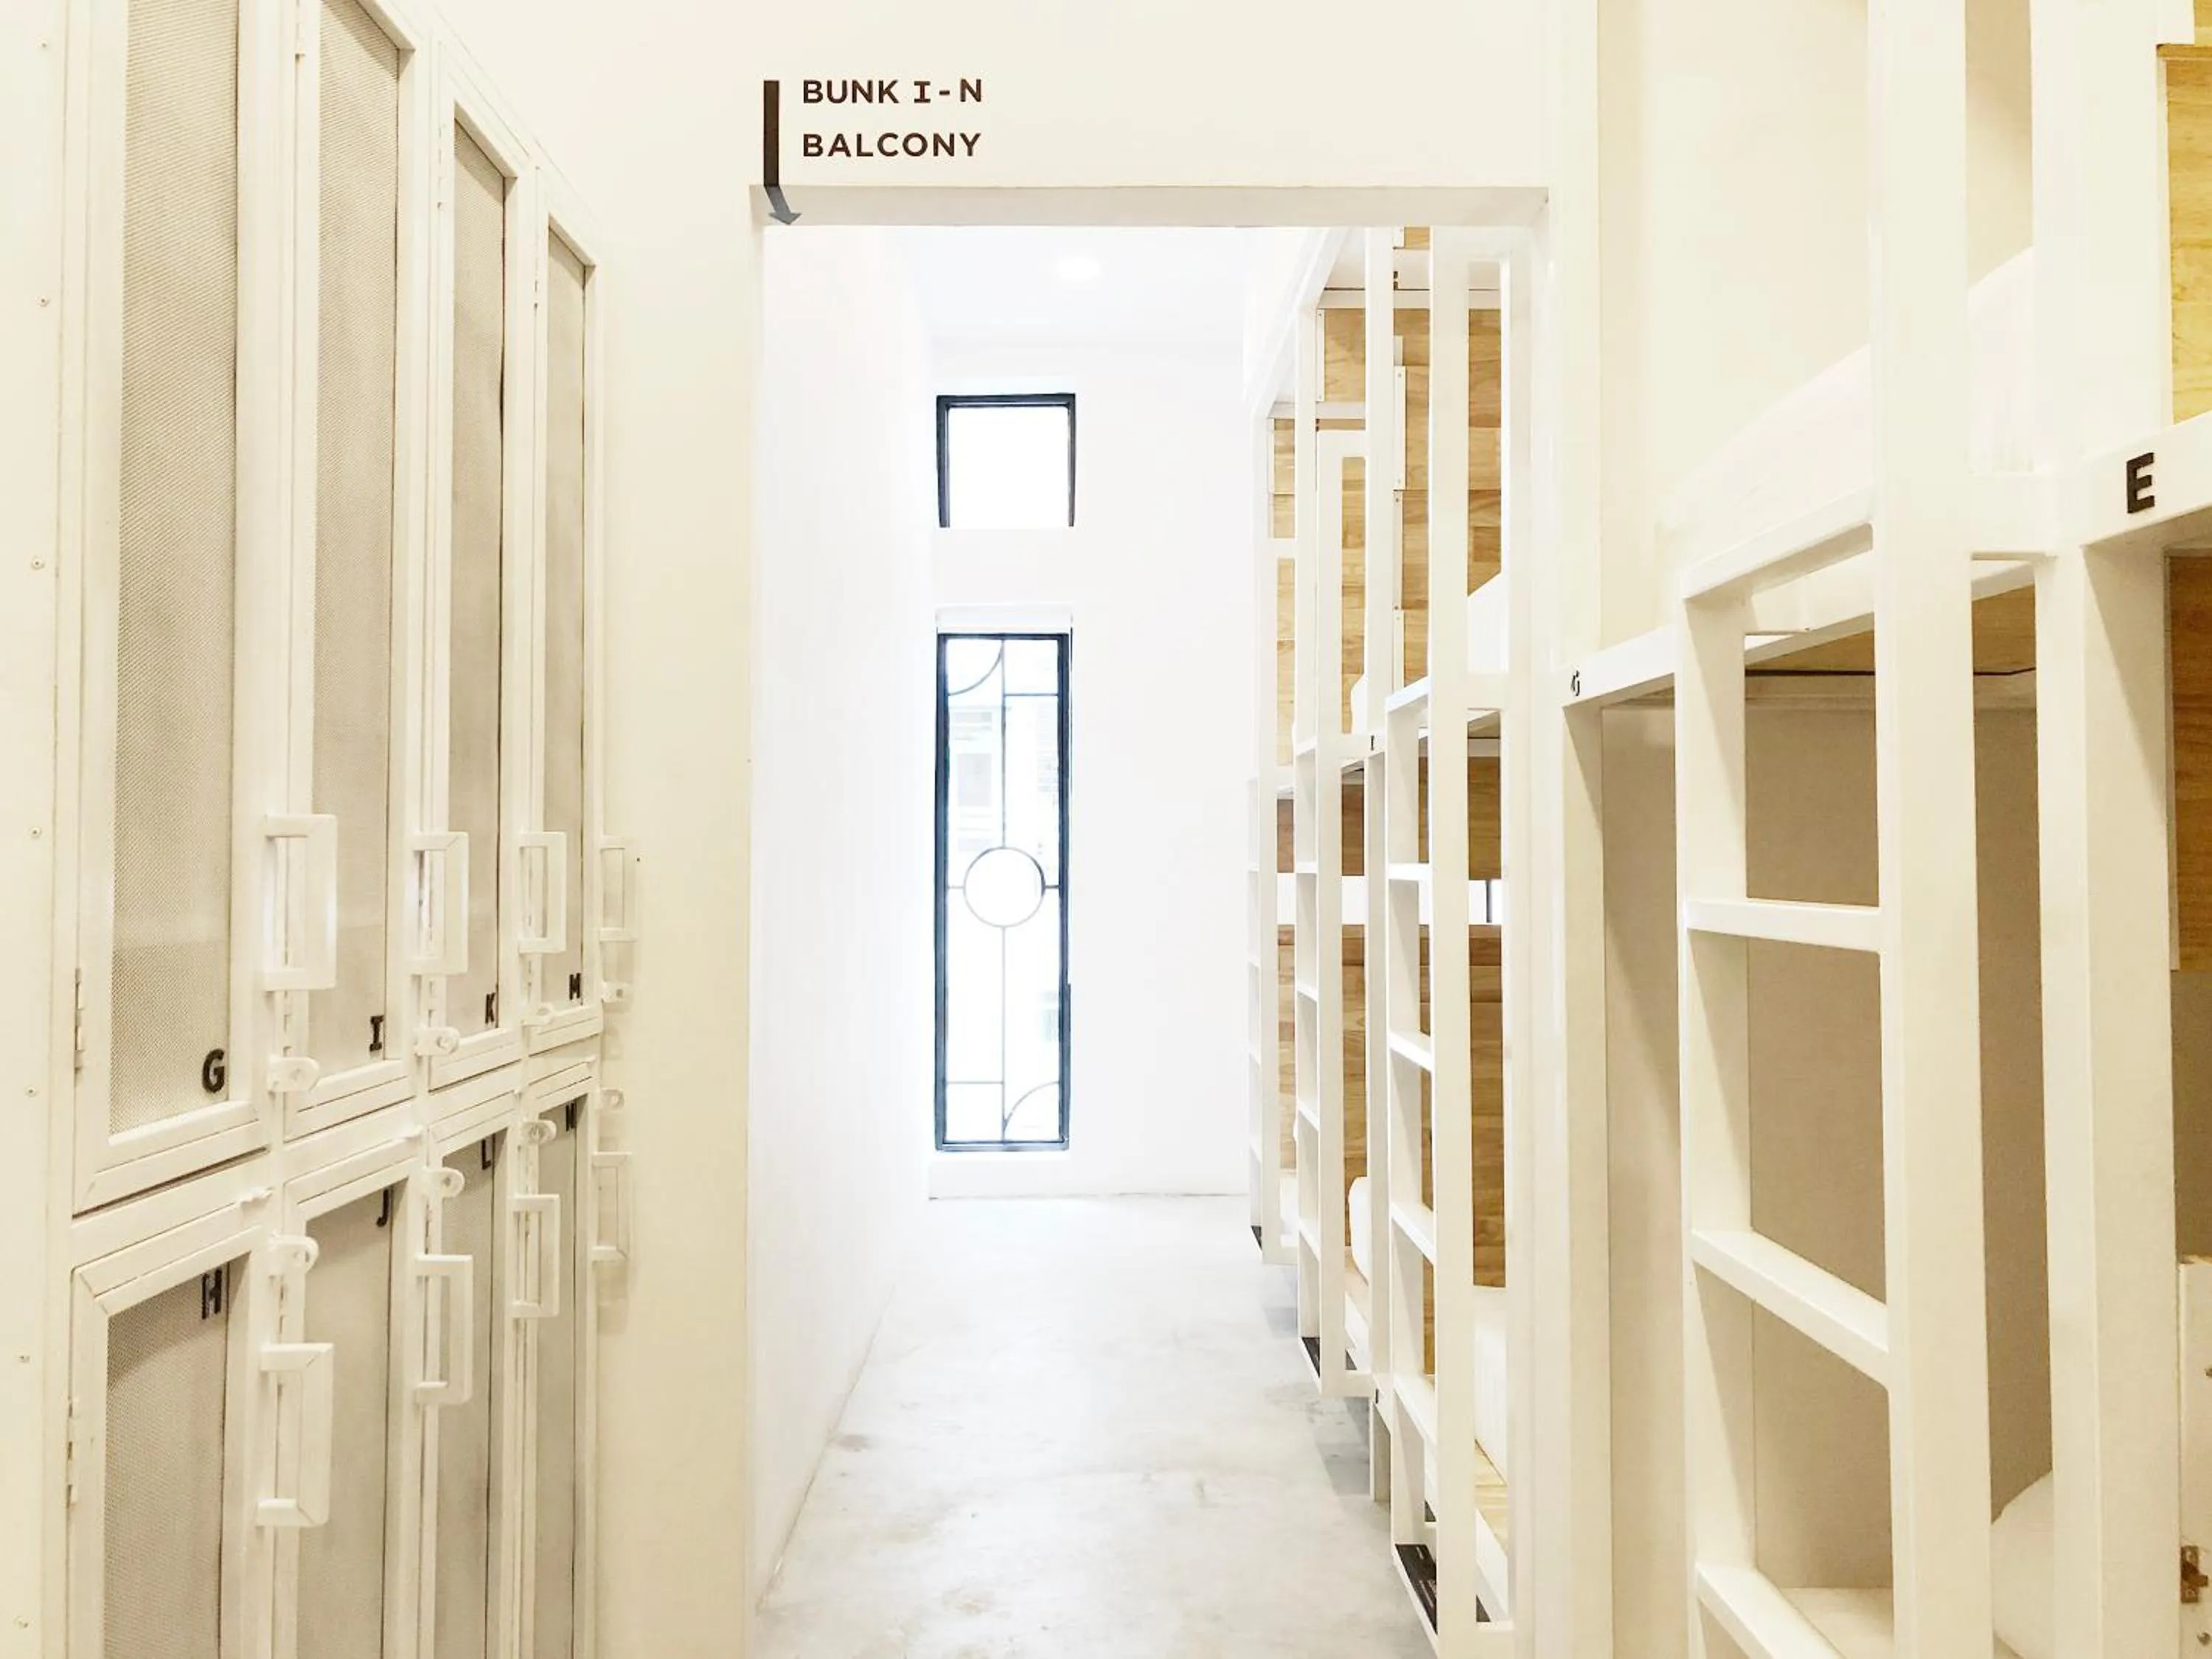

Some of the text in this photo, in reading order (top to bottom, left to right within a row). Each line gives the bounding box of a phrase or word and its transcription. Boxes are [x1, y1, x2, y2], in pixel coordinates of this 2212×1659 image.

[803, 78, 981, 104] BUNK I-N
[803, 132, 981, 157] BALCONY
[2126, 452, 2155, 515] E
[485, 992, 495, 1023] K
[369, 1015, 384, 1052] I
[202, 1048, 225, 1093] G
[481, 1138, 492, 1170] L
[375, 1188, 389, 1228] J
[201, 1267, 222, 1320] H
